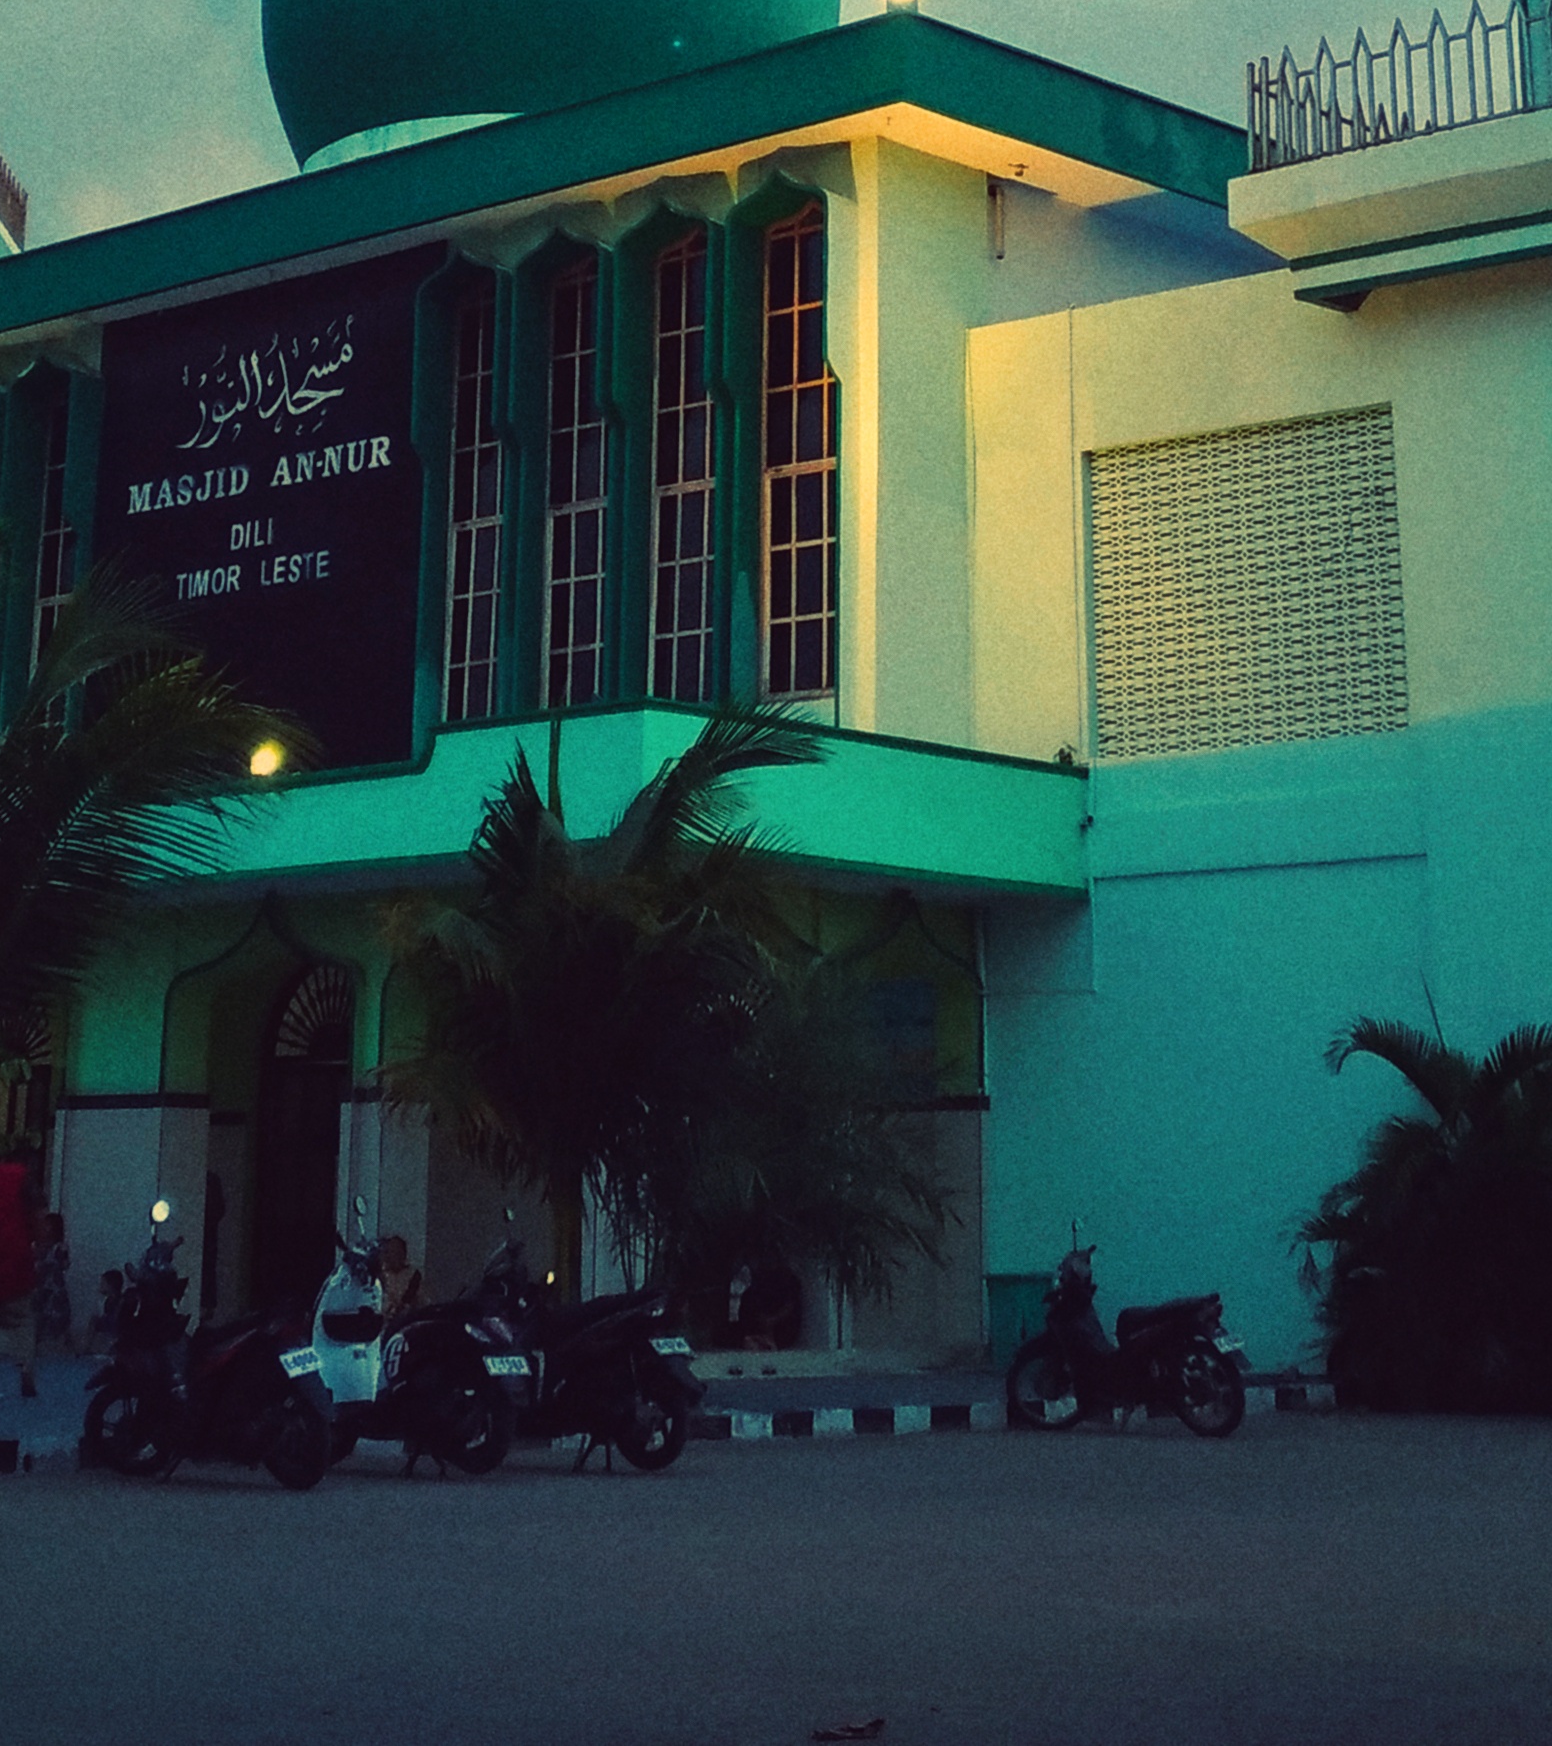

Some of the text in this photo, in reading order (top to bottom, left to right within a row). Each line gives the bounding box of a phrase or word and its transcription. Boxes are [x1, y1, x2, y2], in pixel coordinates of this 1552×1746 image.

[127, 436, 391, 515] MASJID AN-NUR
[230, 517, 273, 551] DILI
[176, 550, 331, 600] TIMOR LESTE
